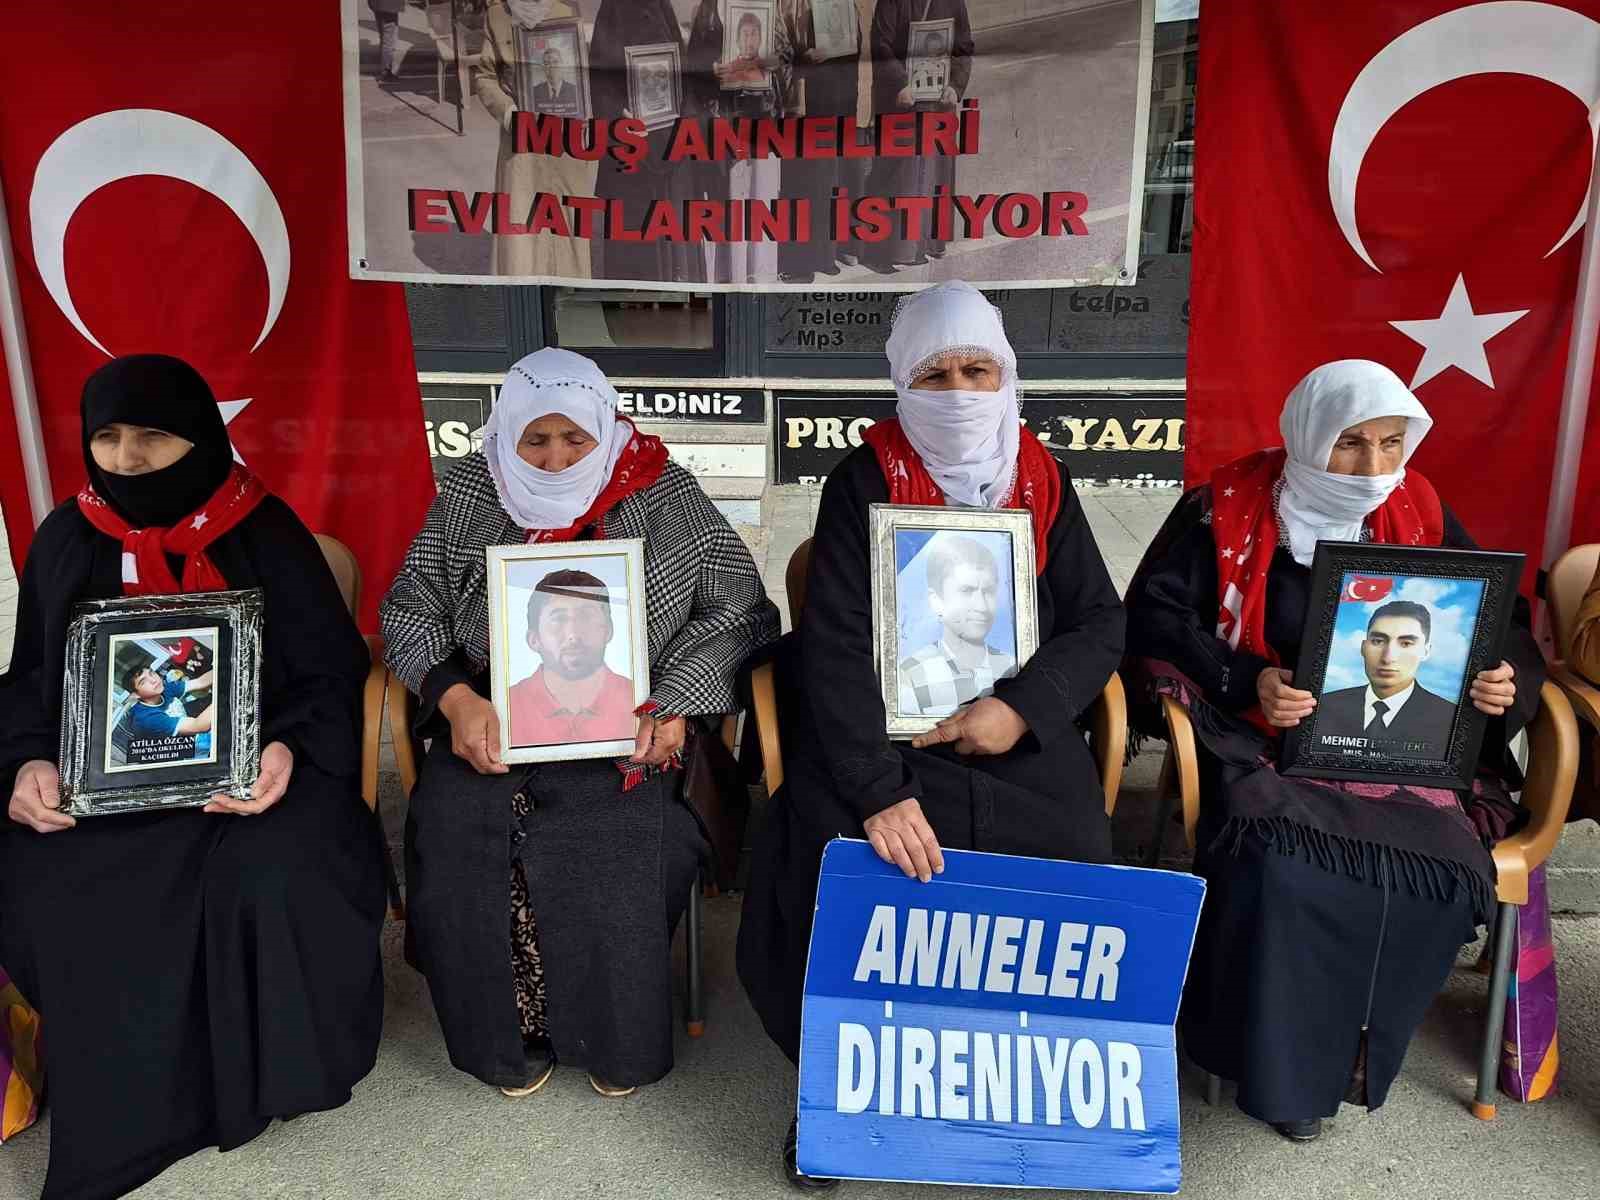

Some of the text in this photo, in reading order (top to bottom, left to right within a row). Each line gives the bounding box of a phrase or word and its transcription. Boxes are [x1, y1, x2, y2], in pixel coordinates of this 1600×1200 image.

[513, 99, 980, 174] MUŞ ANNELERİ
[408, 186, 1089, 242] EVLATLARINI İSTİYOR
[798, 308, 881, 325] Telefon
[798, 330, 844, 350] Mp3
[616, 392, 742, 415] ELDiNiZ
[785, 417, 1186, 451] PRO YAZI
[1321, 735, 1368, 748] MEHMET
[853, 904, 1126, 1001] ANNELER
[836, 1000, 1146, 1131] DİRENİYOR
